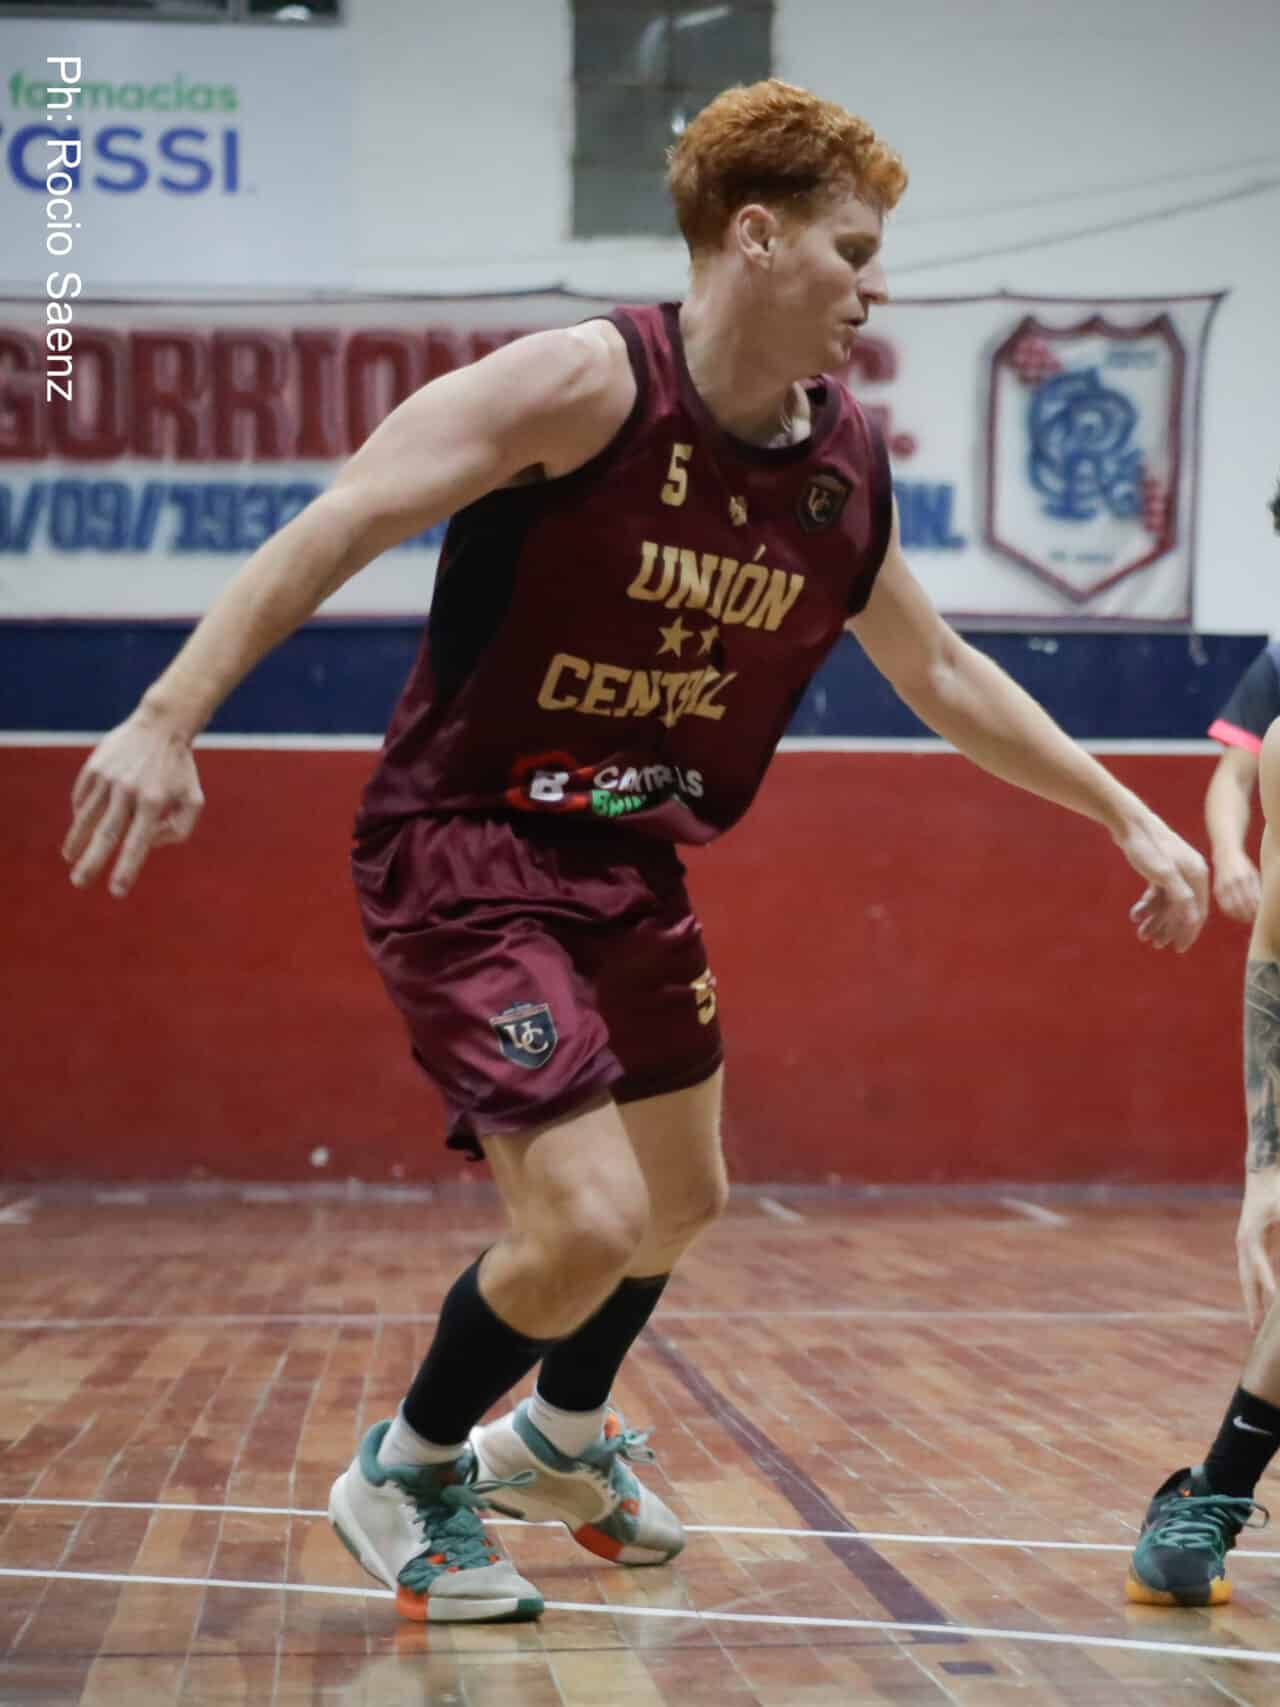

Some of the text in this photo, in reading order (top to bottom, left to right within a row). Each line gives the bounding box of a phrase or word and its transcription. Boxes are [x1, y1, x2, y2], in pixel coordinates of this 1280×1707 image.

[8, 71, 239, 112] farmacias
[660, 443, 694, 507] 5
[627, 541, 805, 631] UNIÓN
[503, 1020, 549, 1054] UC
